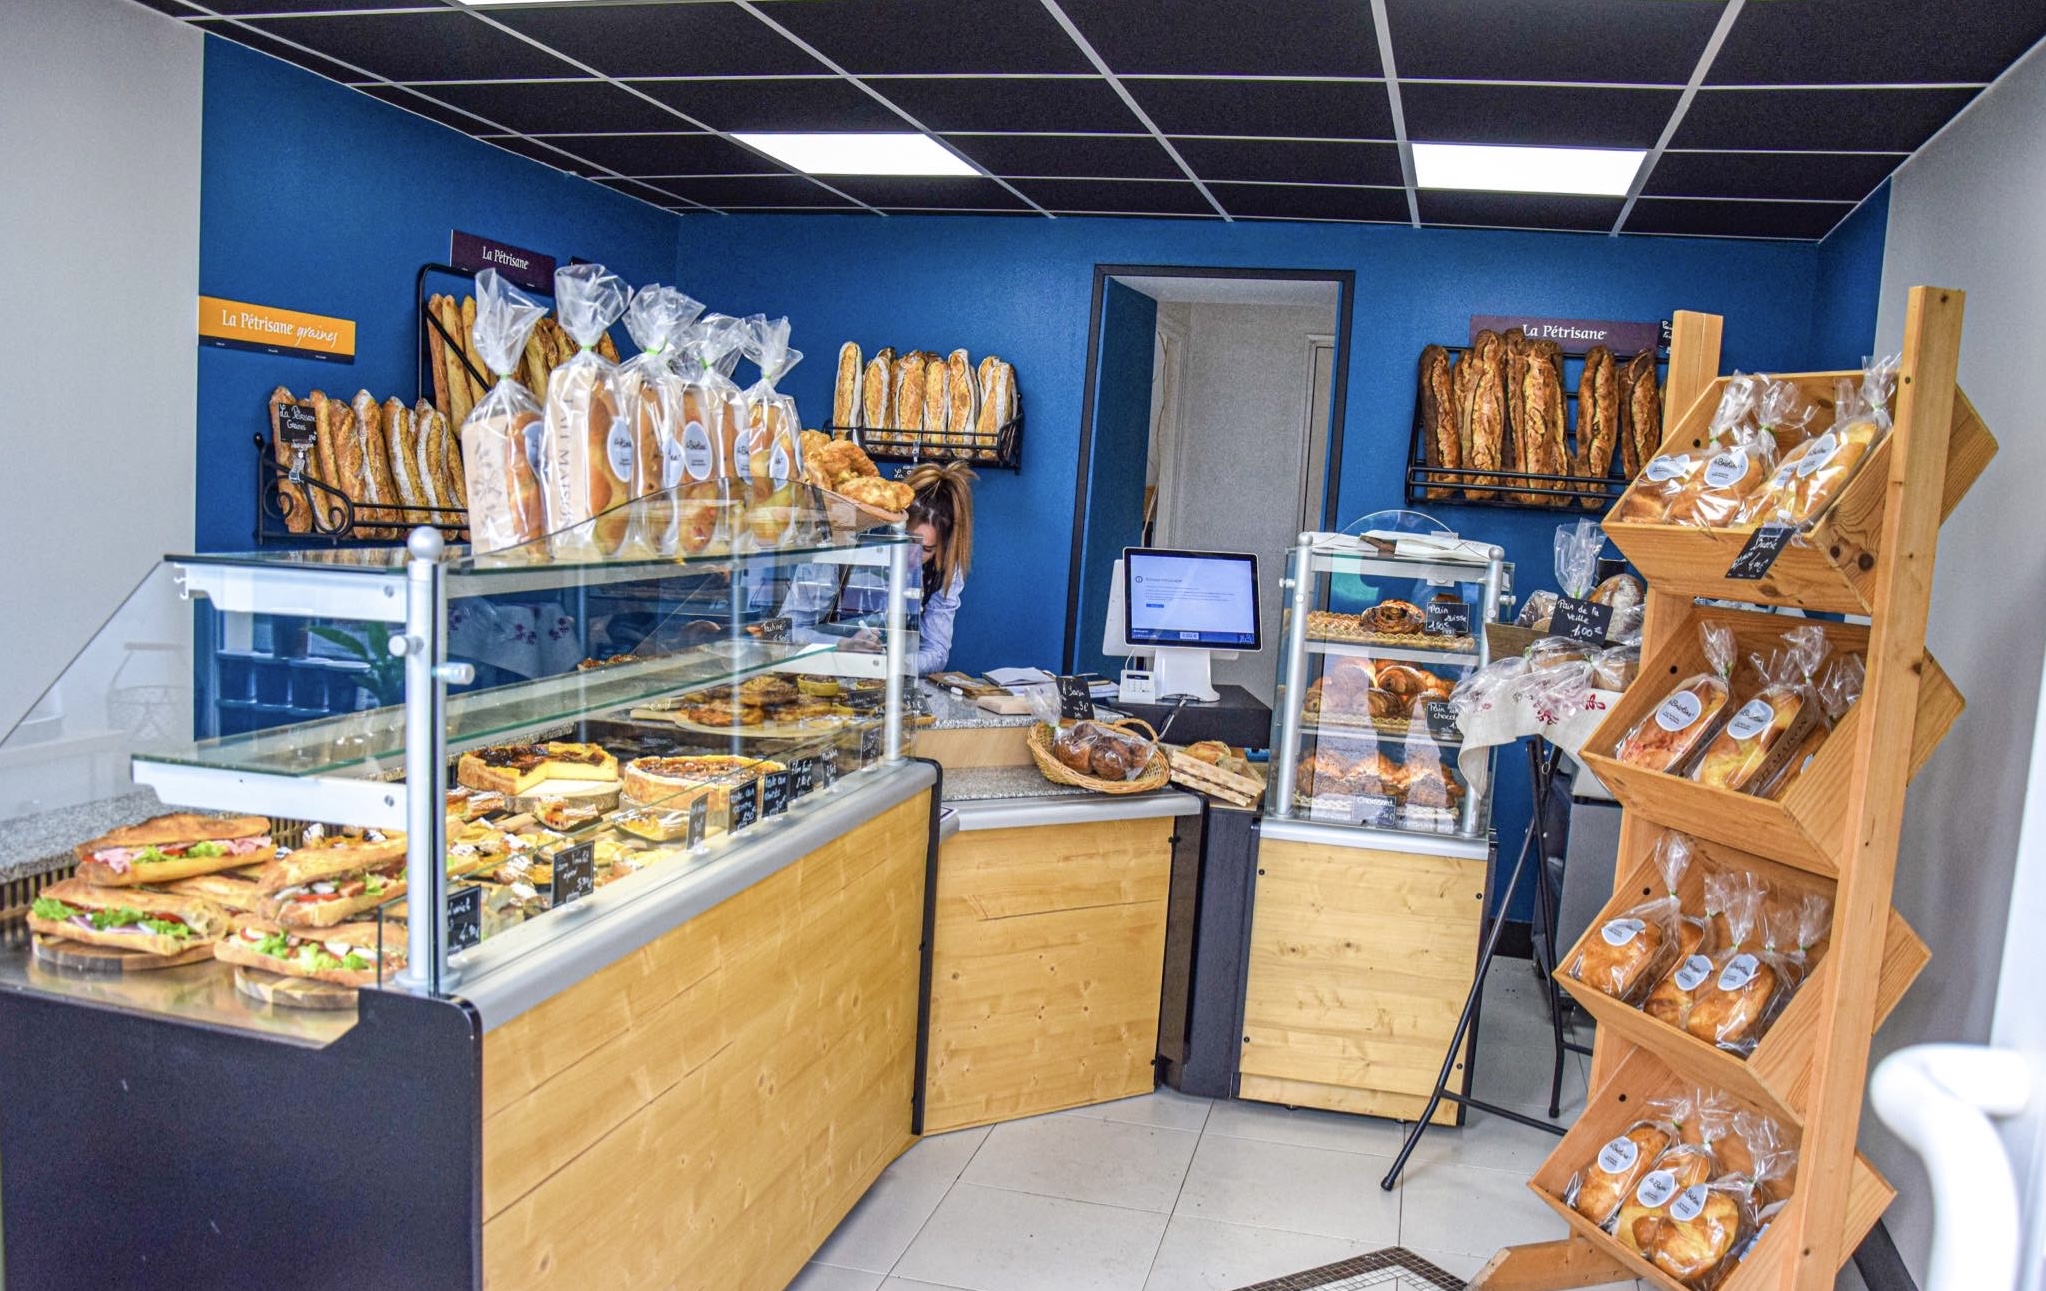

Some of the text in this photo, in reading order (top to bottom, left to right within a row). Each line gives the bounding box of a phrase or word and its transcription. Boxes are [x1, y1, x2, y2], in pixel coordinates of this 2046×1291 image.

[482, 246, 529, 270] La Pétrisane
[222, 309, 338, 349] La Pétrisane graines
[1522, 323, 1606, 340] La Pétrisane
[1429, 604, 1448, 614] Pain
[1557, 599, 1574, 612] Pain
[1578, 605, 1588, 615] de
